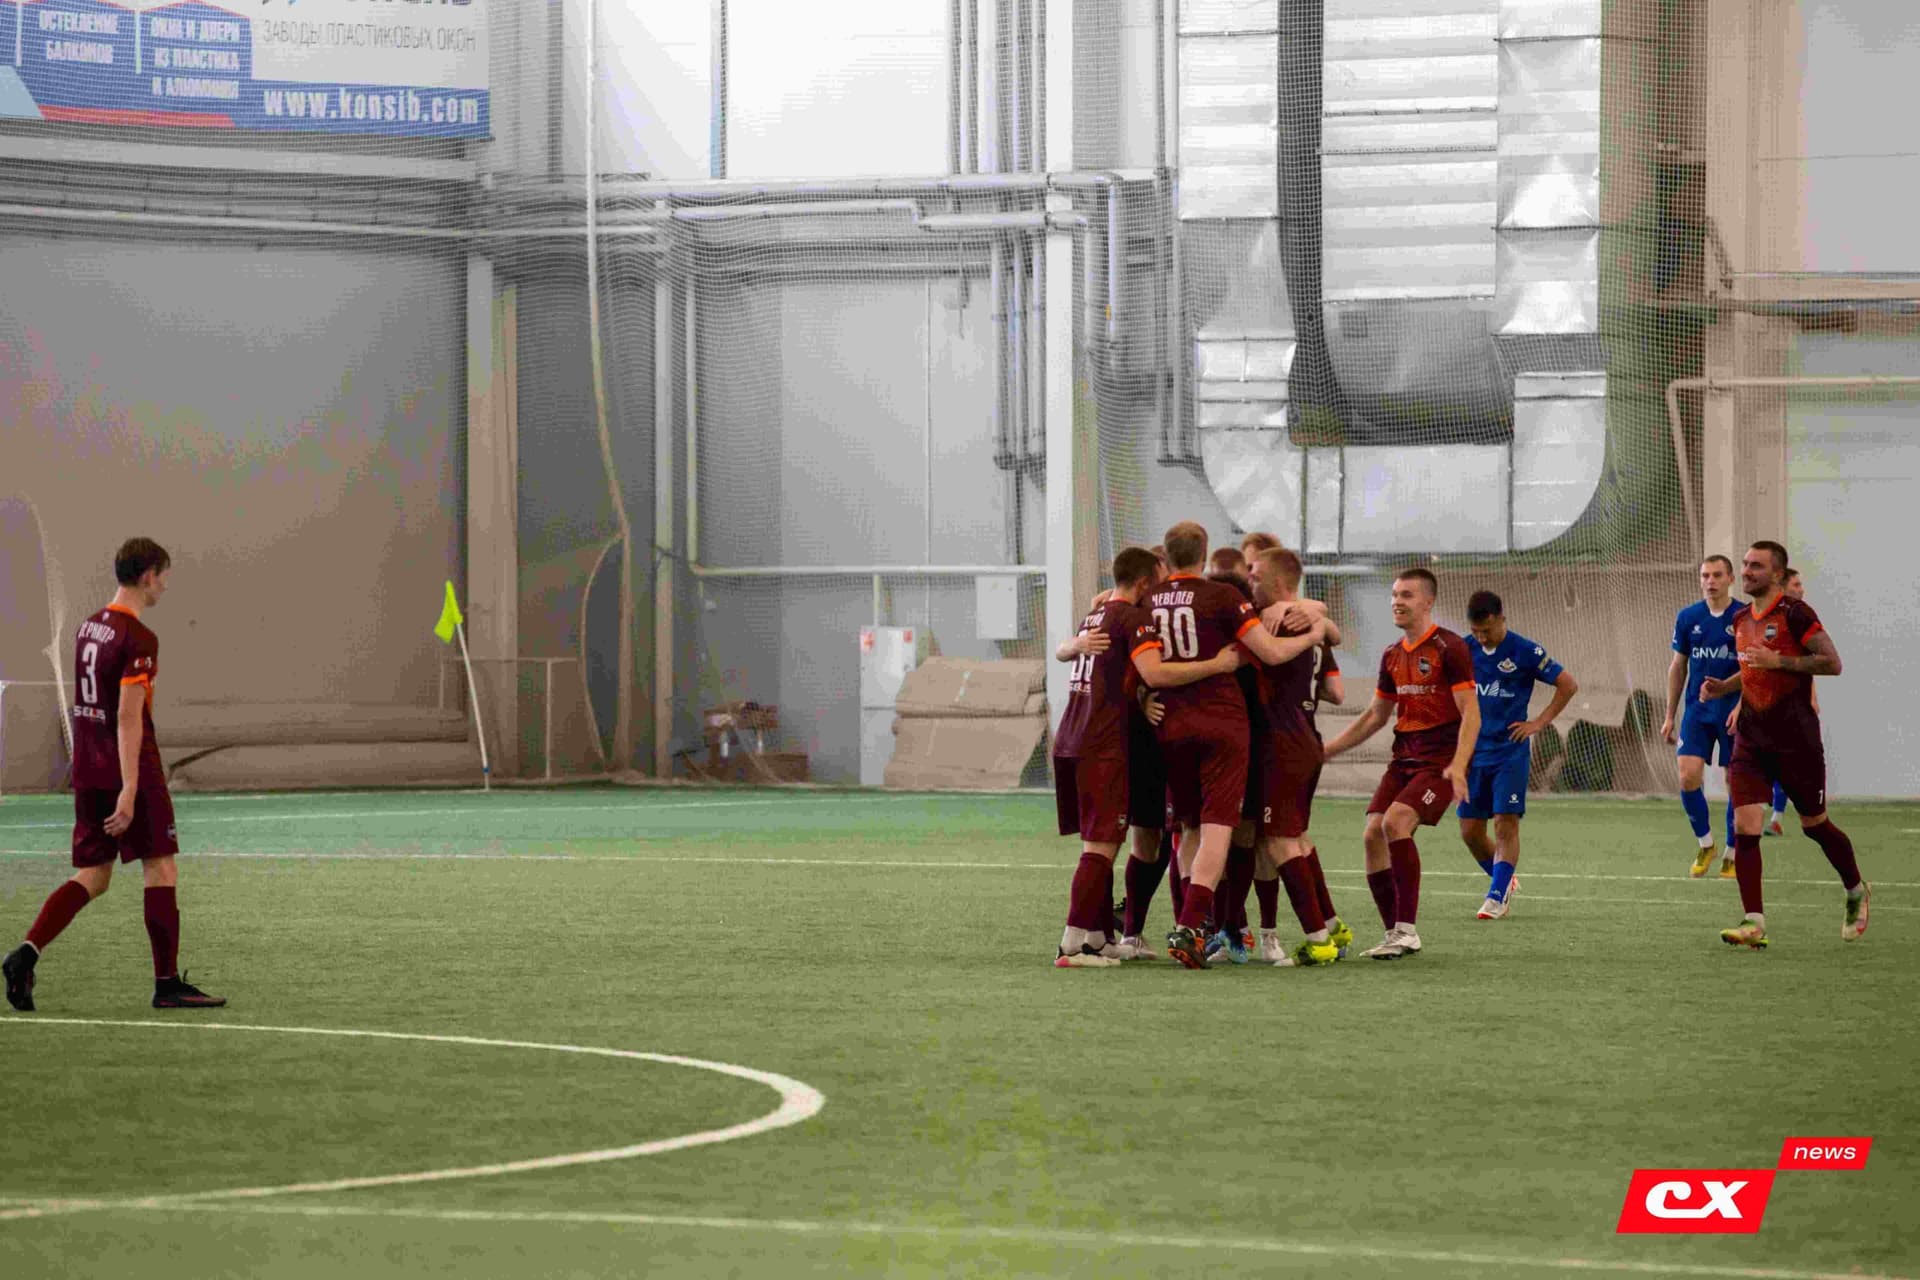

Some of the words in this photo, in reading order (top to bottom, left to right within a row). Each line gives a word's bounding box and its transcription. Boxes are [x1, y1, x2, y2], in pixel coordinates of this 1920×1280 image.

[264, 20, 322, 45] ЗАВОДЫ
[327, 22, 432, 48] ПЛАСТИКОВЫХ
[437, 27, 476, 51] ОКОН
[264, 87, 479, 123] www.konsib.com
[1151, 606, 1199, 661] 30
[1692, 646, 1719, 659] GNV
[81, 642, 98, 704] 3
[1264, 806, 1272, 823] 2
